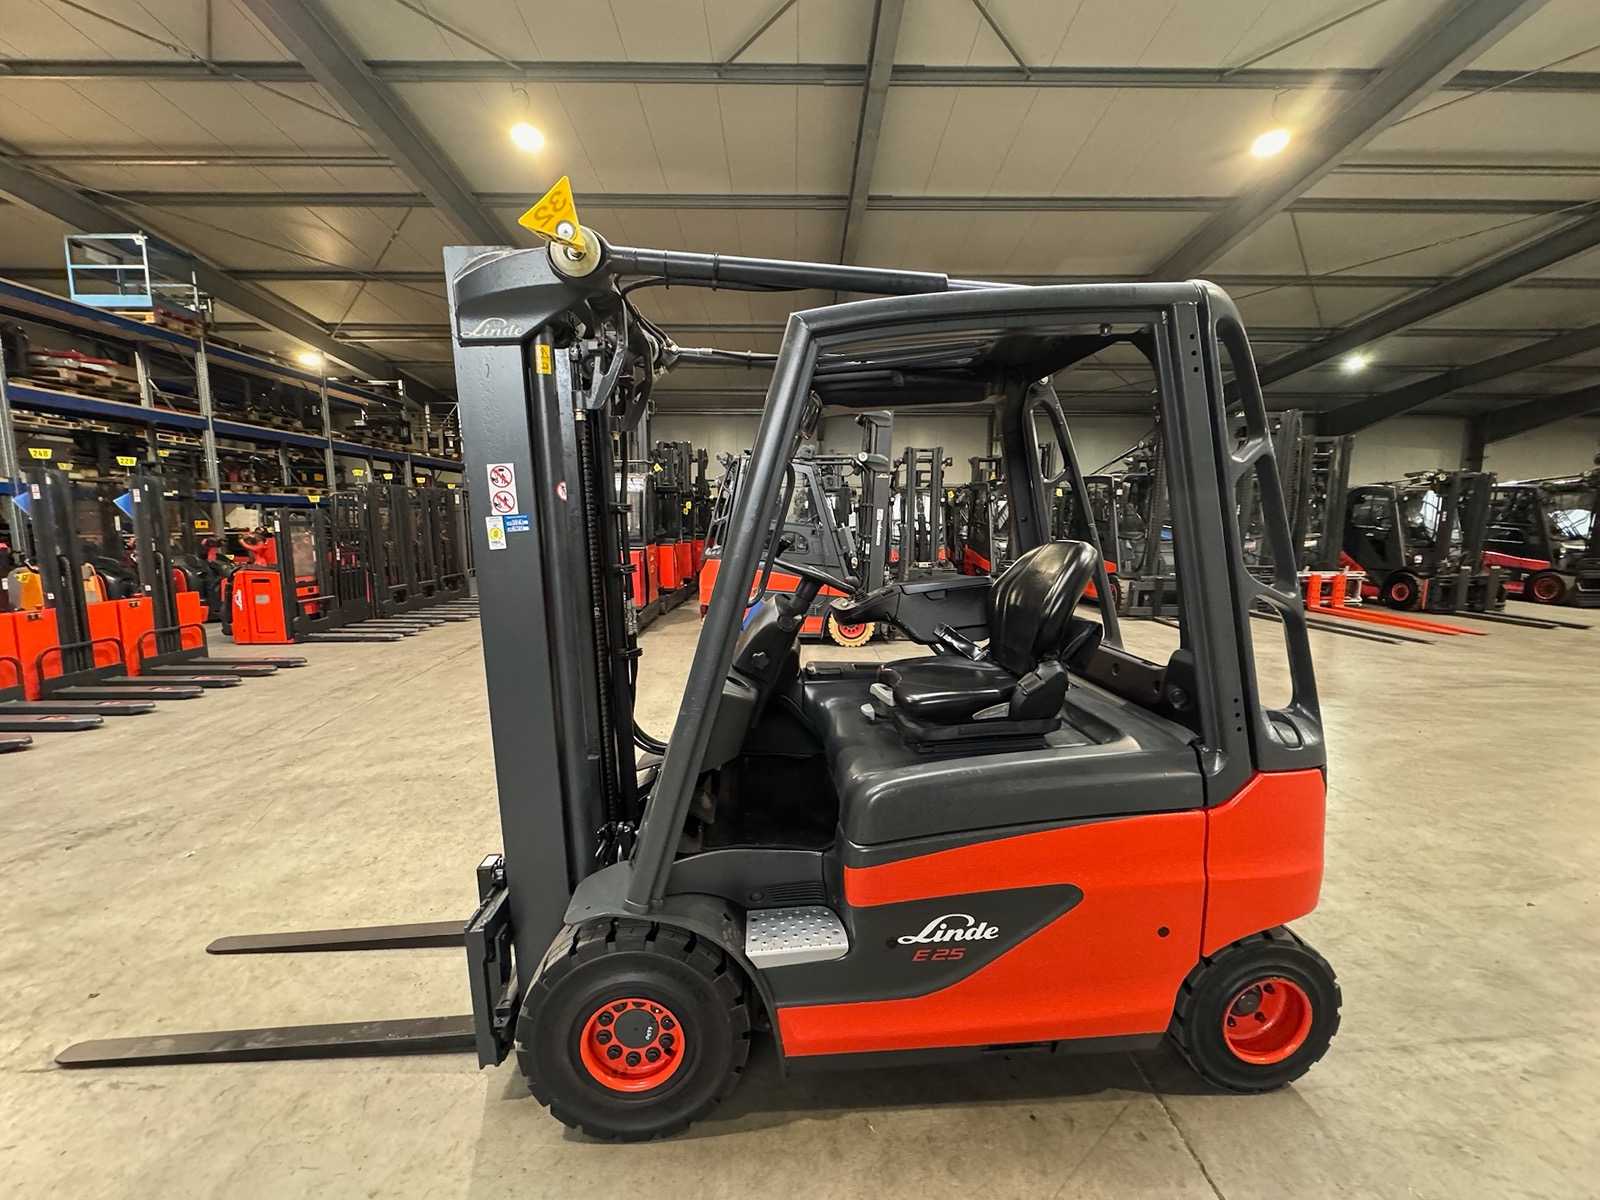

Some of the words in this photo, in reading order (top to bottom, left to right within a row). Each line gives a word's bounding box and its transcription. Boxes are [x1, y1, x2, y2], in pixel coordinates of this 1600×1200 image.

[461, 317, 522, 337] Linde
[897, 913, 999, 945] Linde
[912, 949, 931, 961] E
[931, 947, 967, 961] 25
